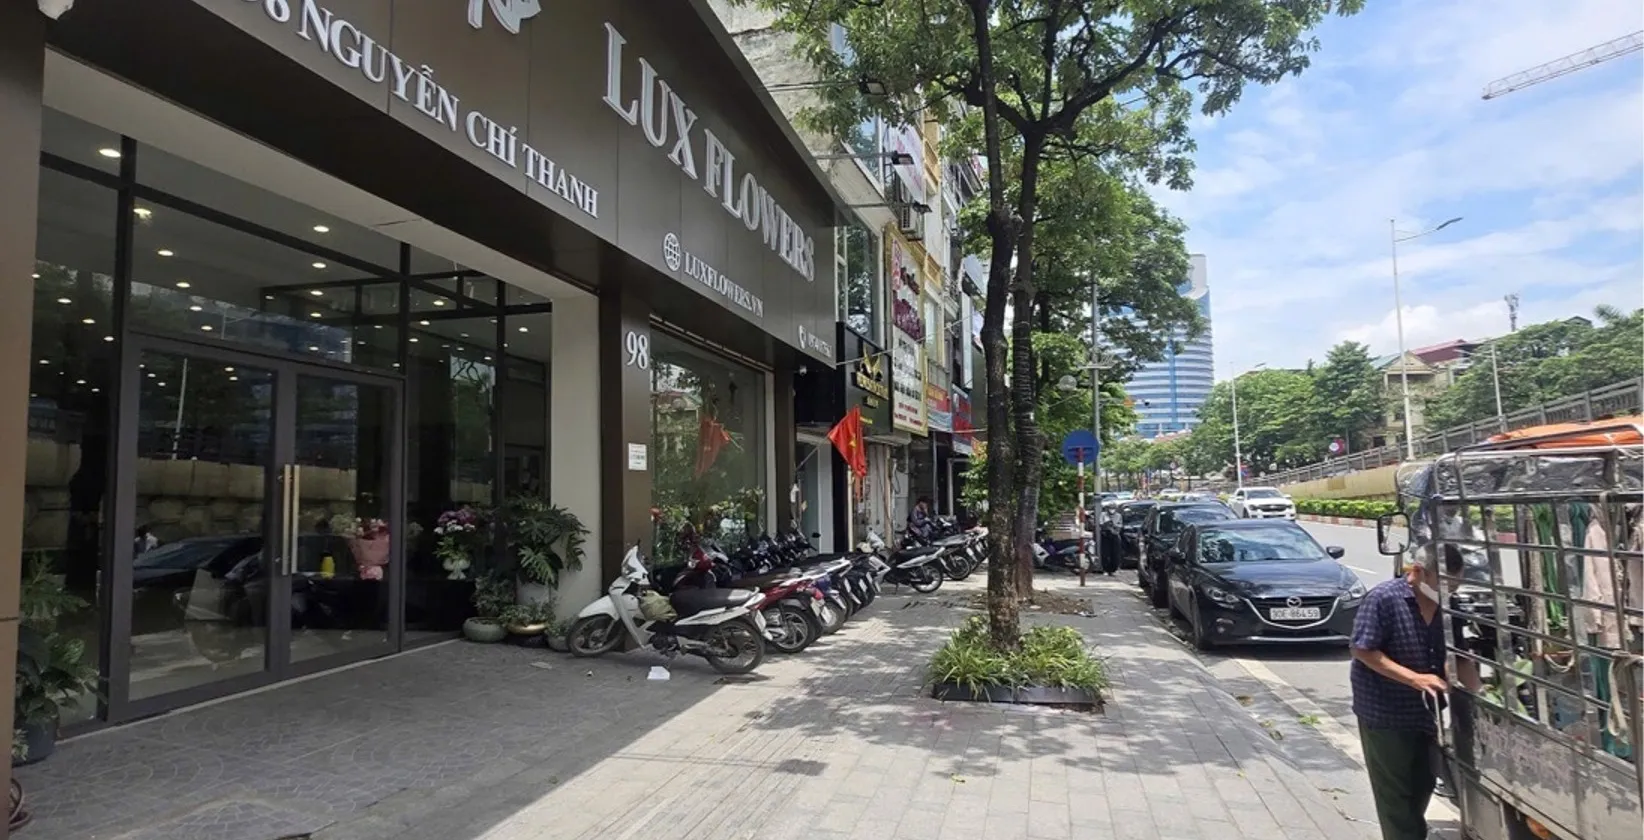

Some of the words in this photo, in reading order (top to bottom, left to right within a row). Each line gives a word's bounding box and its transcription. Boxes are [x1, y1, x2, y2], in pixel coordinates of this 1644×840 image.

[296, 0, 460, 132] NGUYỄN
[465, 110, 518, 168] CHÍ
[522, 142, 599, 219] THANH
[602, 22, 699, 181] LUX
[703, 128, 815, 282] FLOWERS
[626, 331, 649, 370] 98
